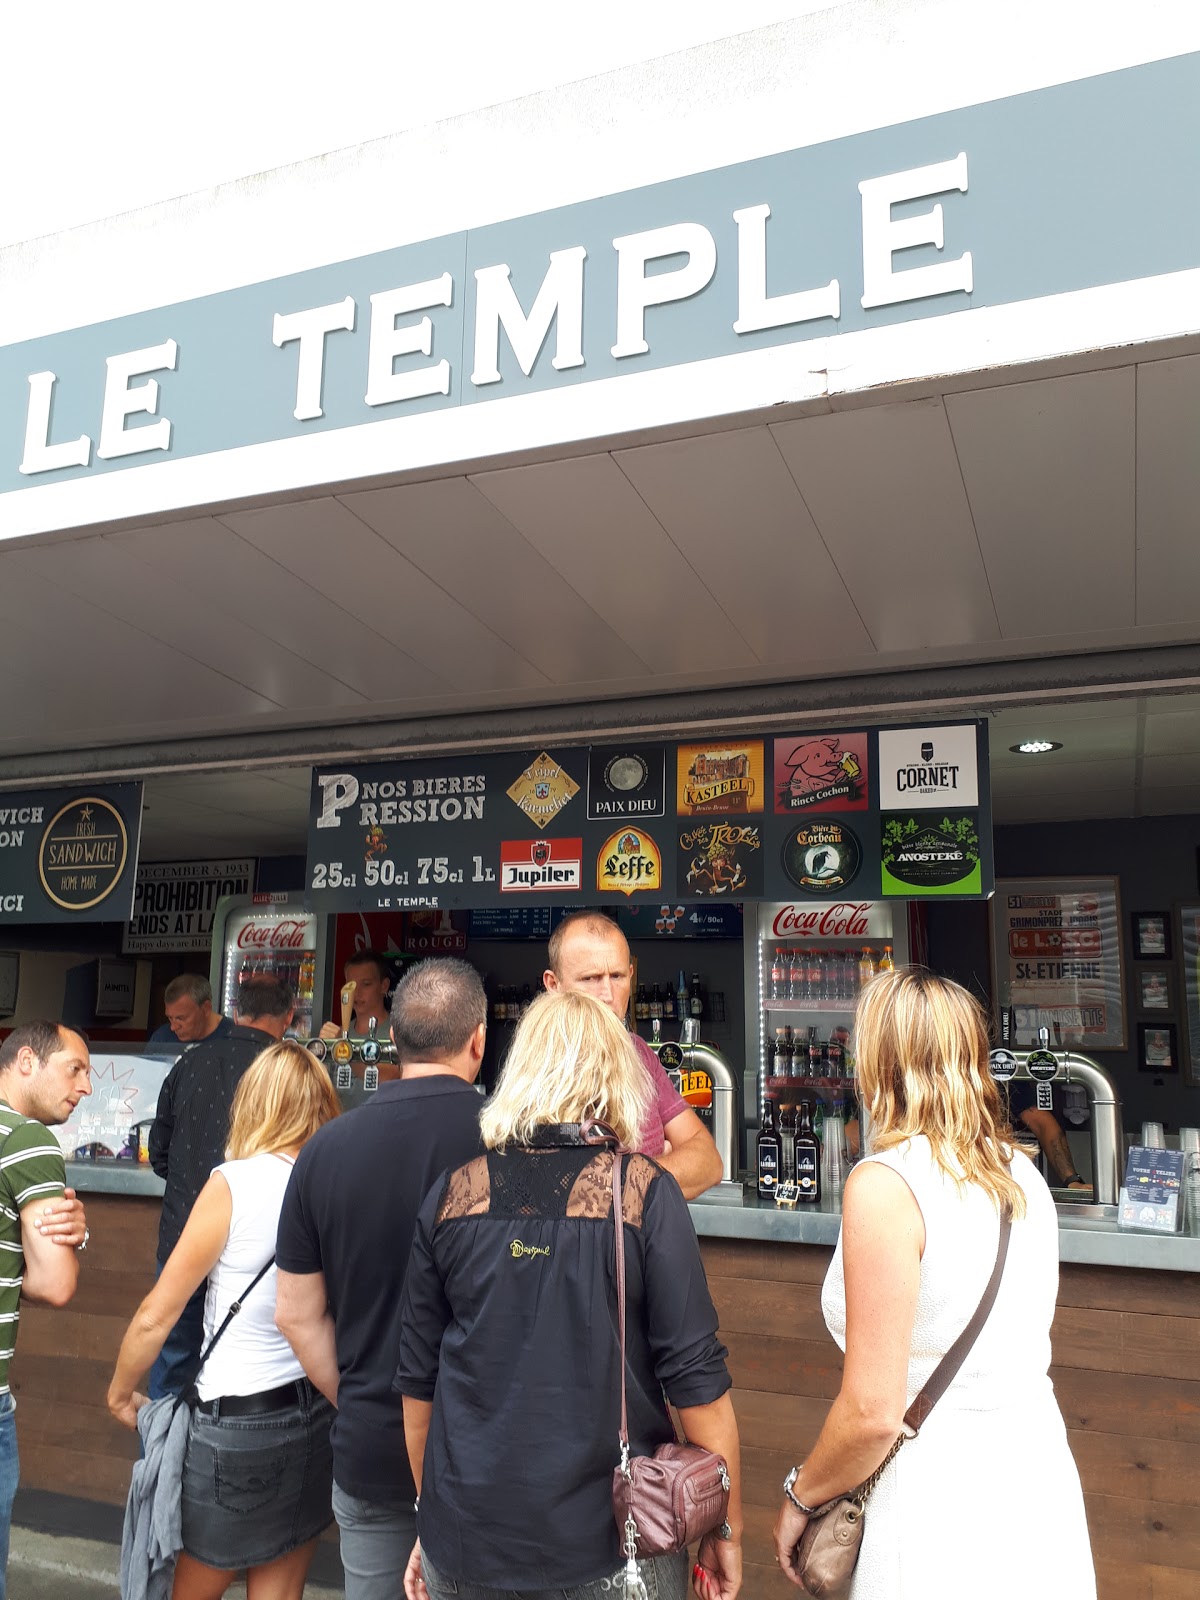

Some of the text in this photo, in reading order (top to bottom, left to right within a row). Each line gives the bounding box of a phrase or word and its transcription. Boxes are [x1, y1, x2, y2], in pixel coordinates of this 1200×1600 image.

[19, 152, 975, 476] LE TEMPLE
[522, 763, 562, 781] Tripel
[896, 765, 960, 792] CORNET
[361, 775, 486, 799] NOS BIERES
[686, 778, 747, 804] KASTEEL
[790, 785, 850, 808] Rince Cochon
[596, 799, 657, 814] PAIX DIEU
[76, 822, 97, 837] FRESH
[796, 831, 842, 847] Corbeau
[48, 841, 118, 865] SANDWICH
[897, 850, 964, 862] ANOSTEKÉ
[136, 865, 209, 878] DECEMBER
[224, 864, 249, 874] 1933
[311, 856, 496, 888] 25cl 50cl 75cl 1L
[507, 866, 574, 887] Jupiler
[602, 854, 655, 880] Leffe
[61, 875, 98, 891] HOME MADE
[133, 879, 249, 912] PROHIBITION
[378, 898, 391, 907] LE
[397, 896, 439, 907] TEMPLE
[1008, 896, 1021, 908] 51
[128, 914, 169, 935] ENDS
[174, 913, 195, 933] AT
[772, 902, 874, 937] Coca-Cola
[1010, 916, 1063, 928] GRIMONPREZ
[236, 920, 310, 949] Coca-Cola
[408, 936, 464, 948] ROUGE
[1013, 933, 1028, 948] le
[128, 940, 154, 951] Happy
[156, 939, 174, 949] days
[176, 940, 189, 948] are
